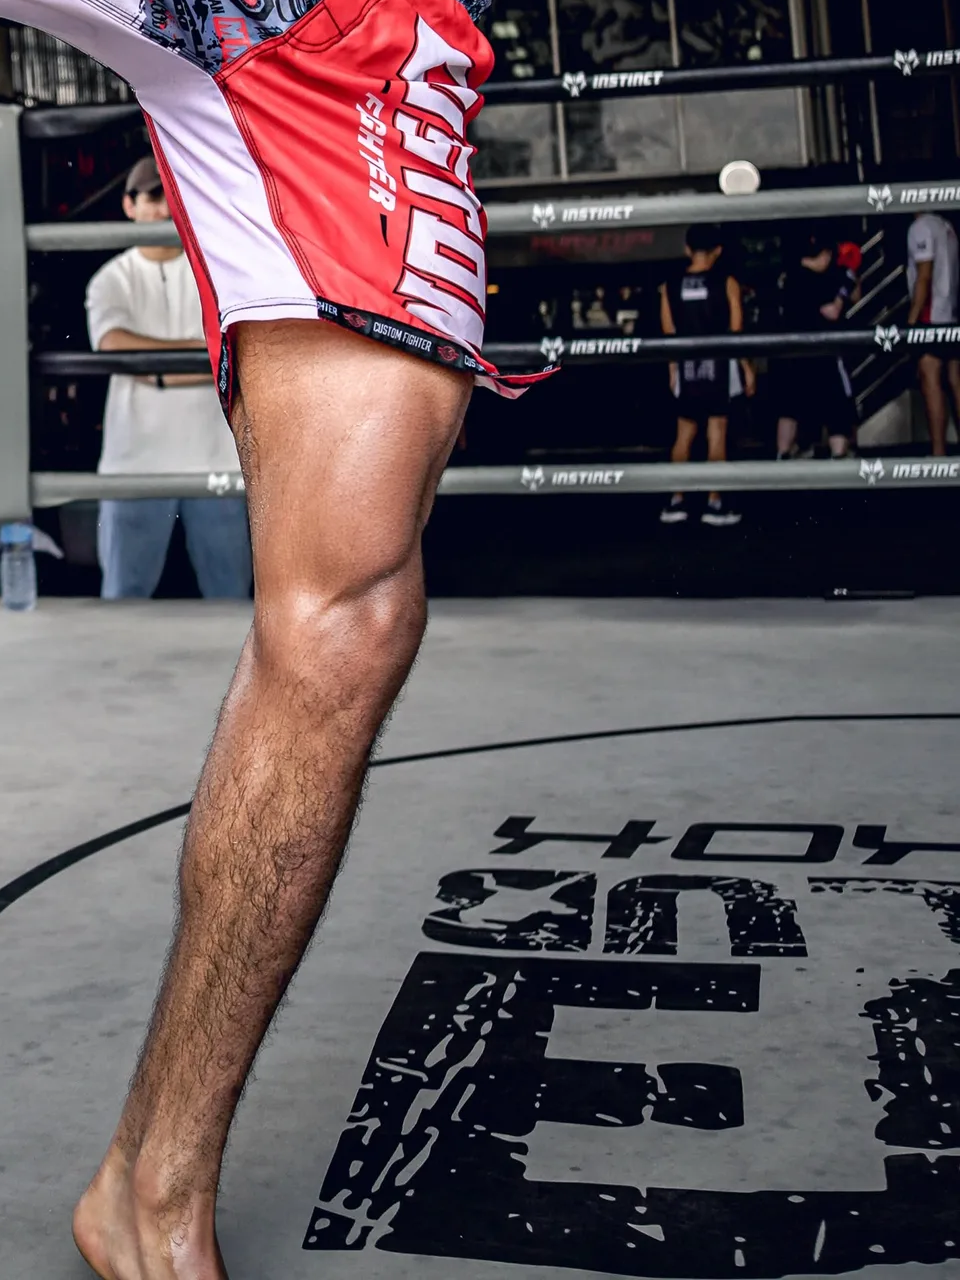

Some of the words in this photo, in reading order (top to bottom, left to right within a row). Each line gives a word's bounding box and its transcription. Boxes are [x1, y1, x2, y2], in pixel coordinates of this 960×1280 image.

[592, 70, 664, 90] INSTINCT
[356, 92, 397, 212] FIGHTER
[562, 204, 634, 223] INSTINCT
[372, 321, 402, 342] CUSTOM
[402, 331, 433, 353] FIGHTER
[570, 337, 642, 355] INSTINCT
[551, 470, 625, 486] INSTINCT
